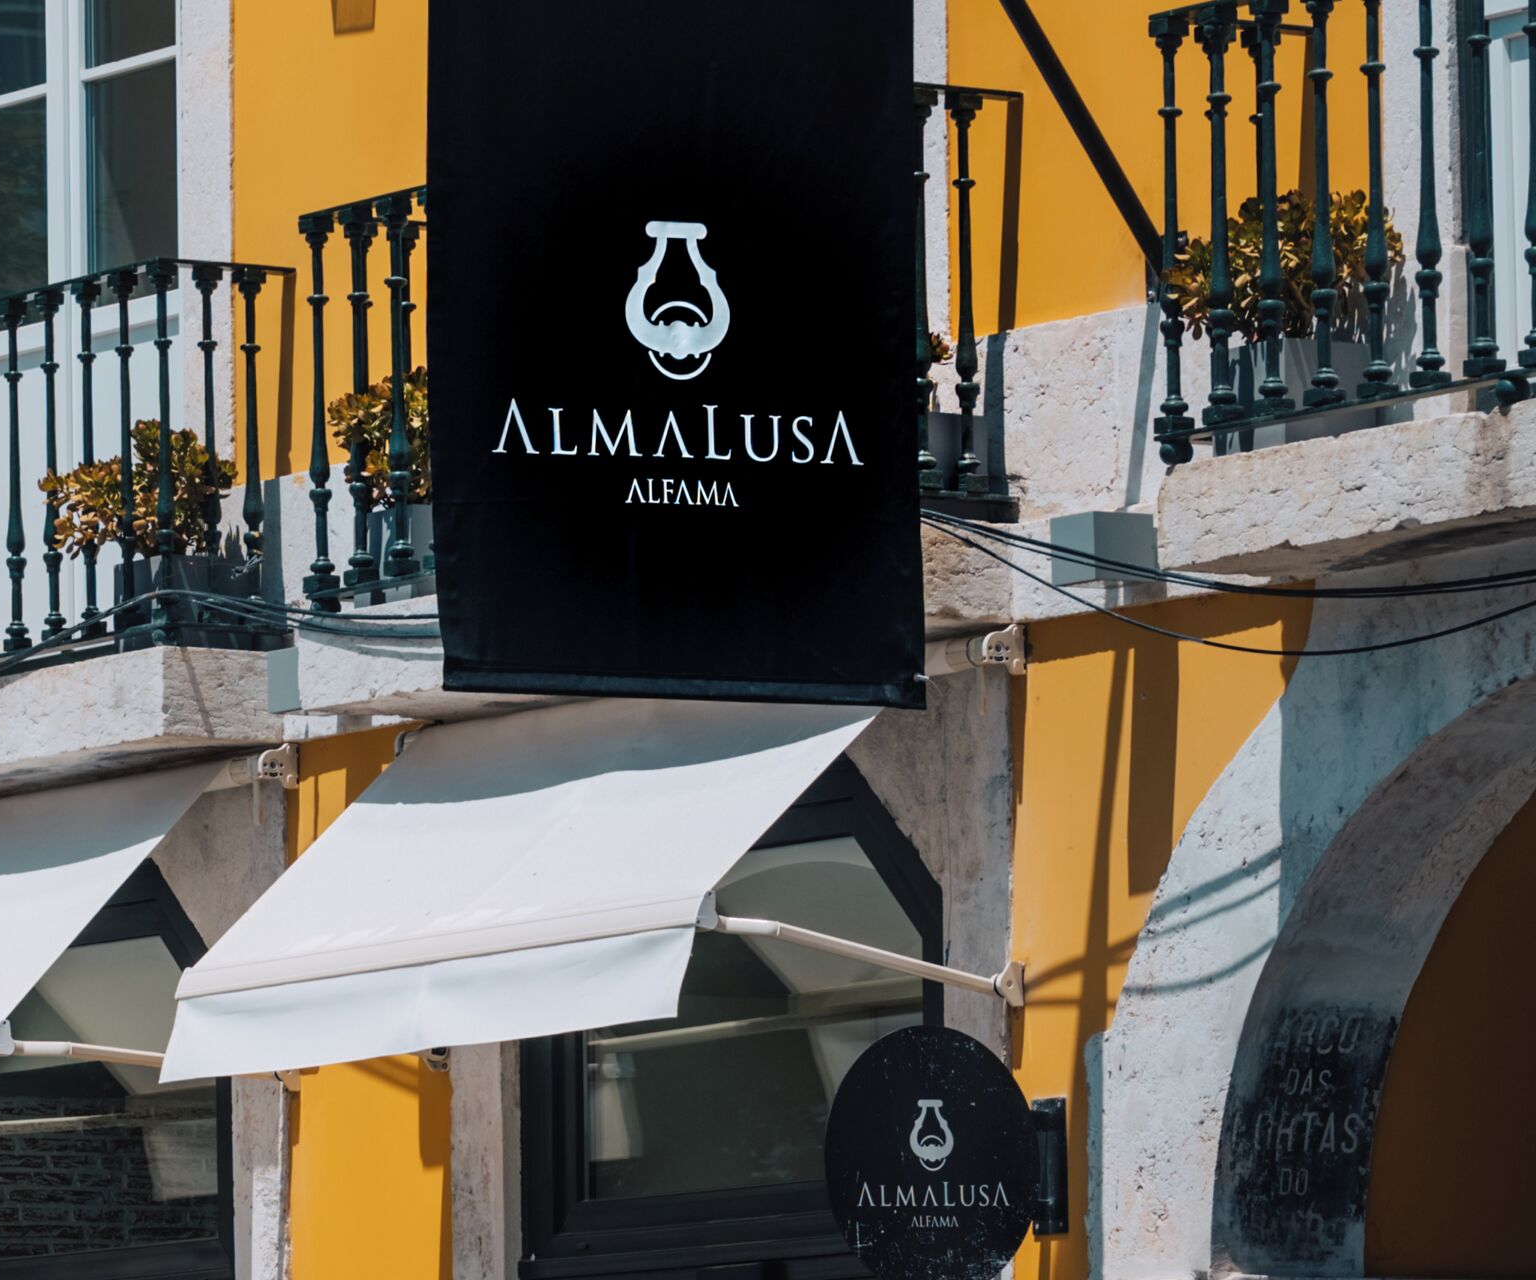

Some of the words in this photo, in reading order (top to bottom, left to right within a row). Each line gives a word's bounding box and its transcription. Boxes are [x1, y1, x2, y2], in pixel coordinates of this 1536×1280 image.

[492, 397, 864, 466] ALMALUSA
[625, 478, 740, 507] ALFAMA
[857, 1181, 1011, 1207] ALMALUSA
[1279, 1168, 1309, 1196] DO
[911, 1215, 959, 1228] ALFAMA
